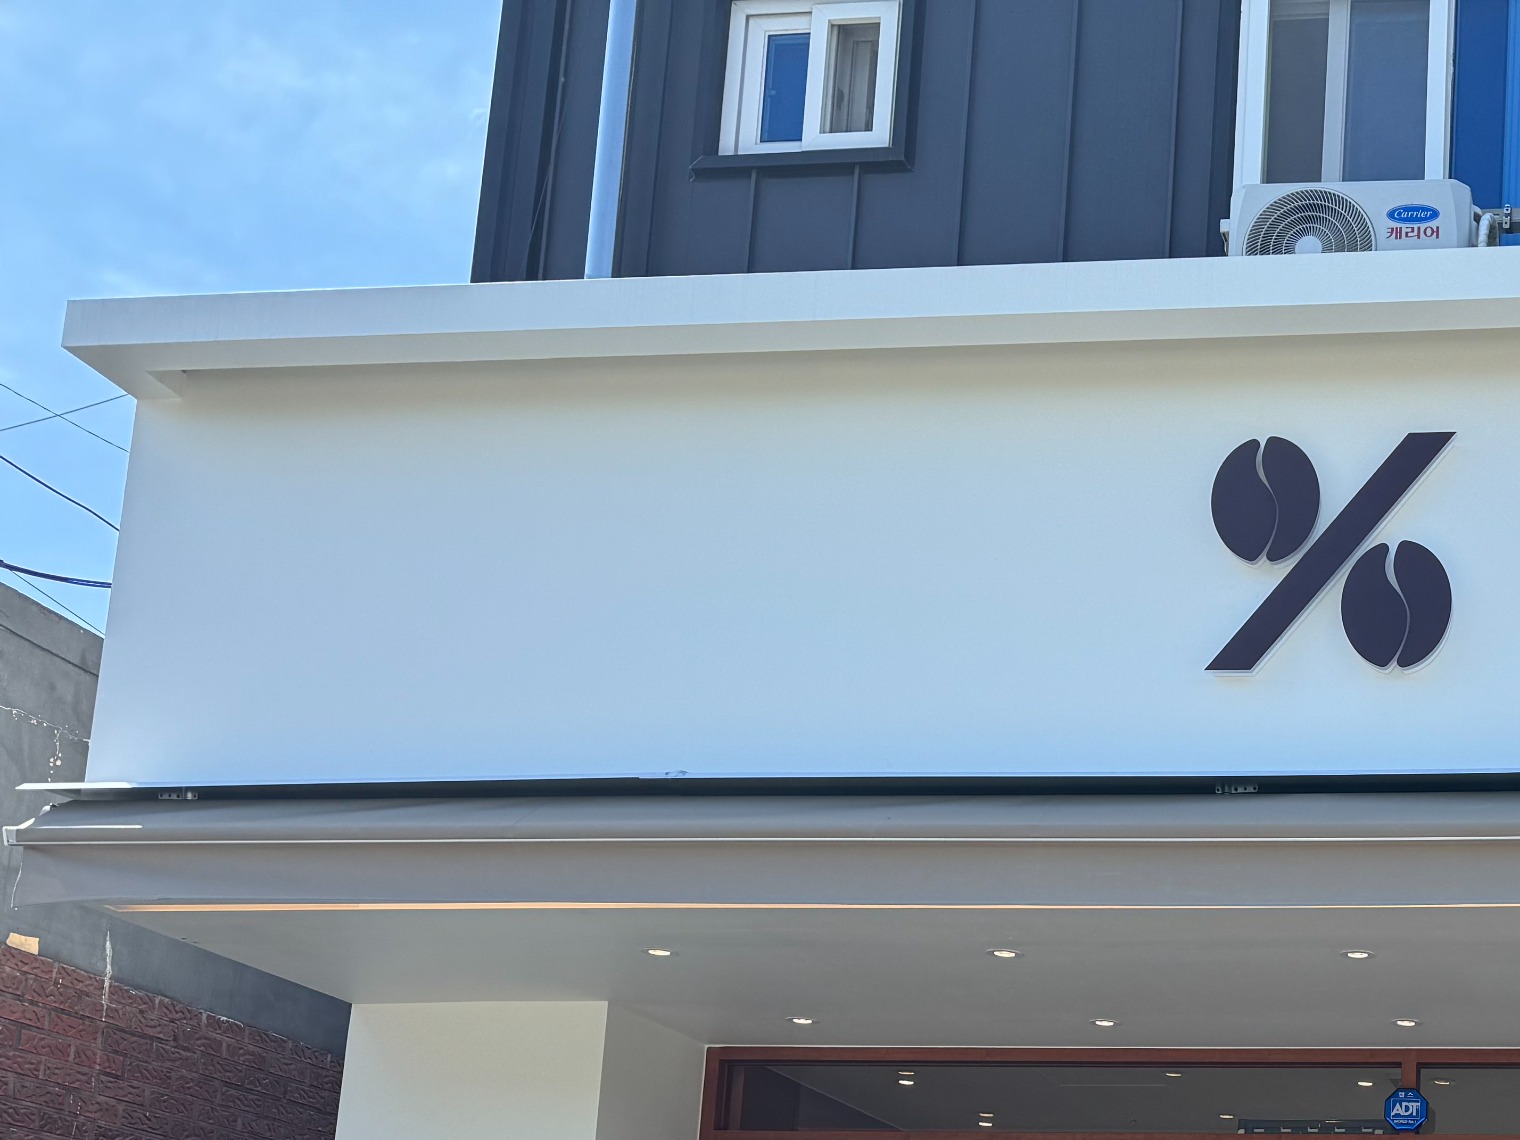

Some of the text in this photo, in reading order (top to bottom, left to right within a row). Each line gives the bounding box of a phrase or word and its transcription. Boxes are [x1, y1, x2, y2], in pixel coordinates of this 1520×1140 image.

[1394, 208, 1432, 218] Carrier
[1386, 226, 1440, 240] 캐리어
[1392, 1102, 1420, 1116] ADT
